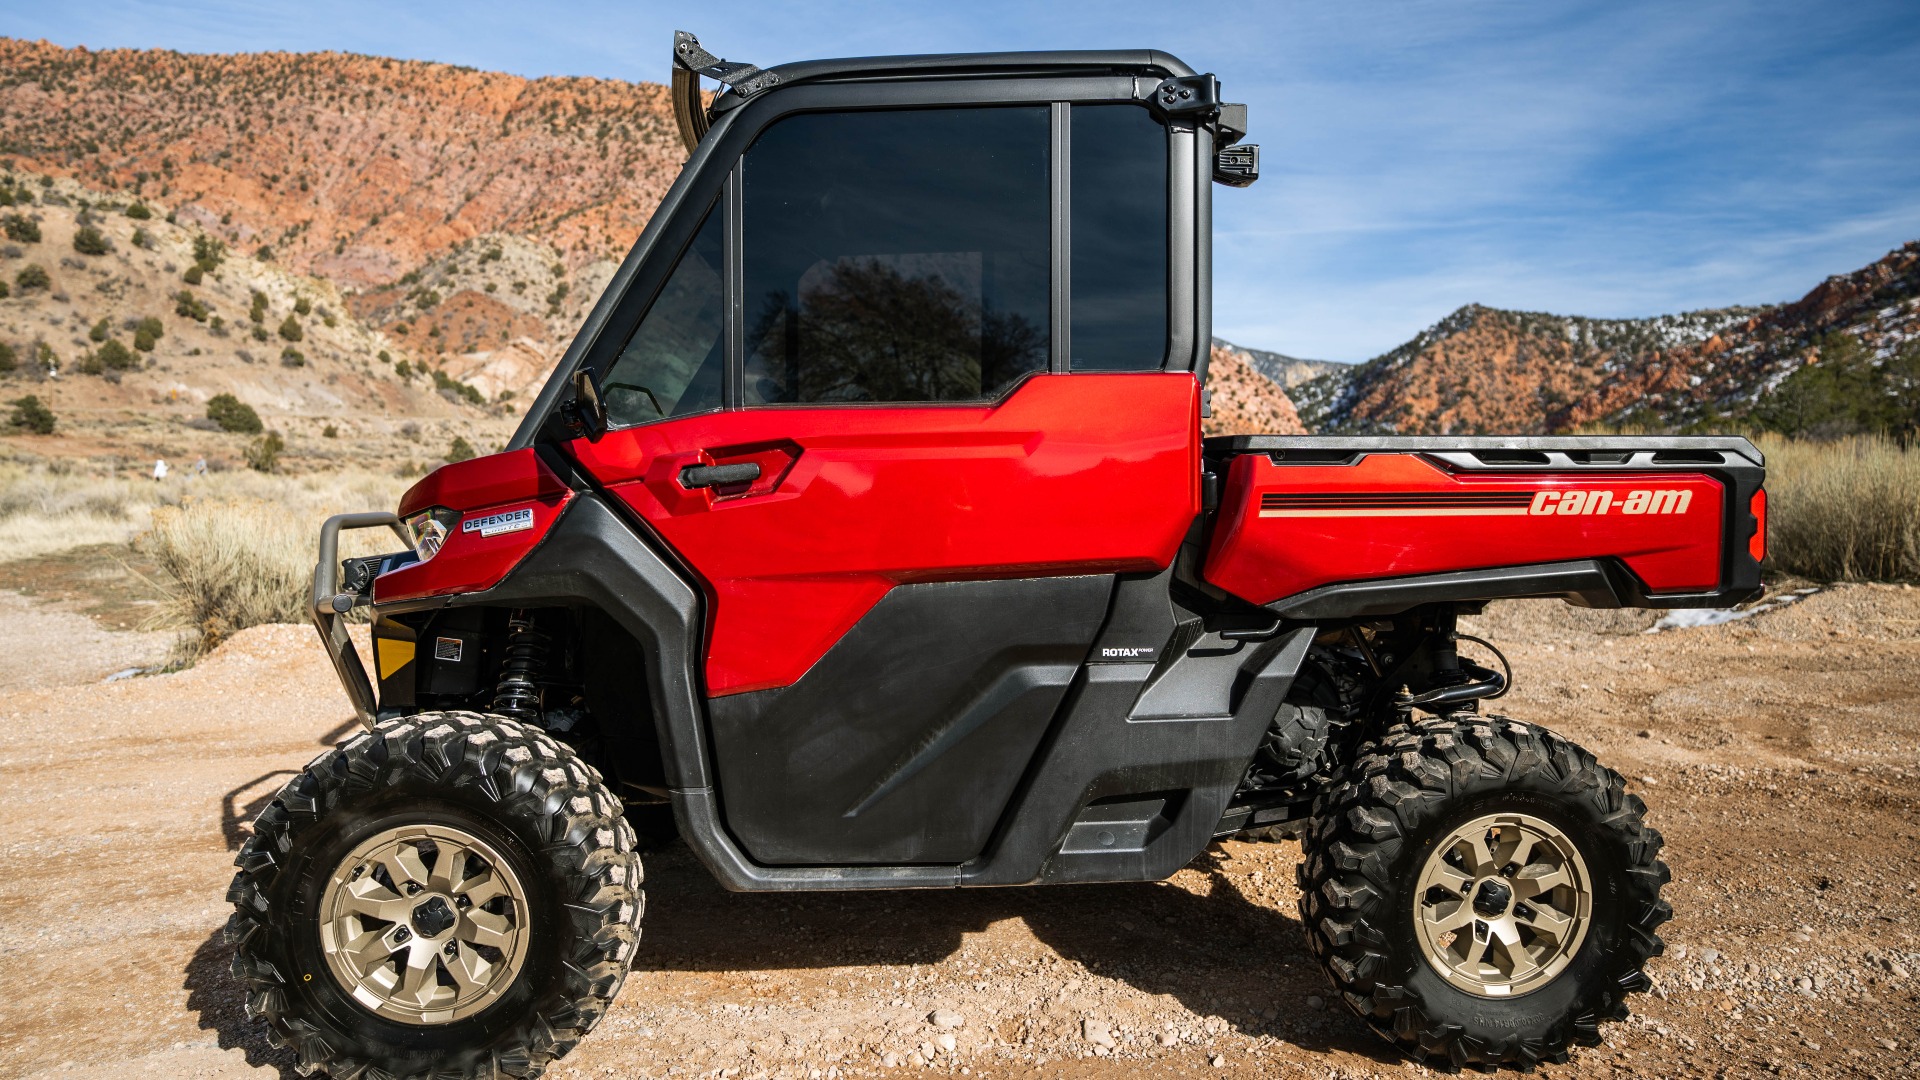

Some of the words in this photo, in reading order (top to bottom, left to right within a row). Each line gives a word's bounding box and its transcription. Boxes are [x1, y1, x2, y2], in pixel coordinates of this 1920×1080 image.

[1530, 490, 1693, 515] can-am
[464, 510, 530, 529] DEFENDER
[1102, 648, 1138, 656] ROTAX
